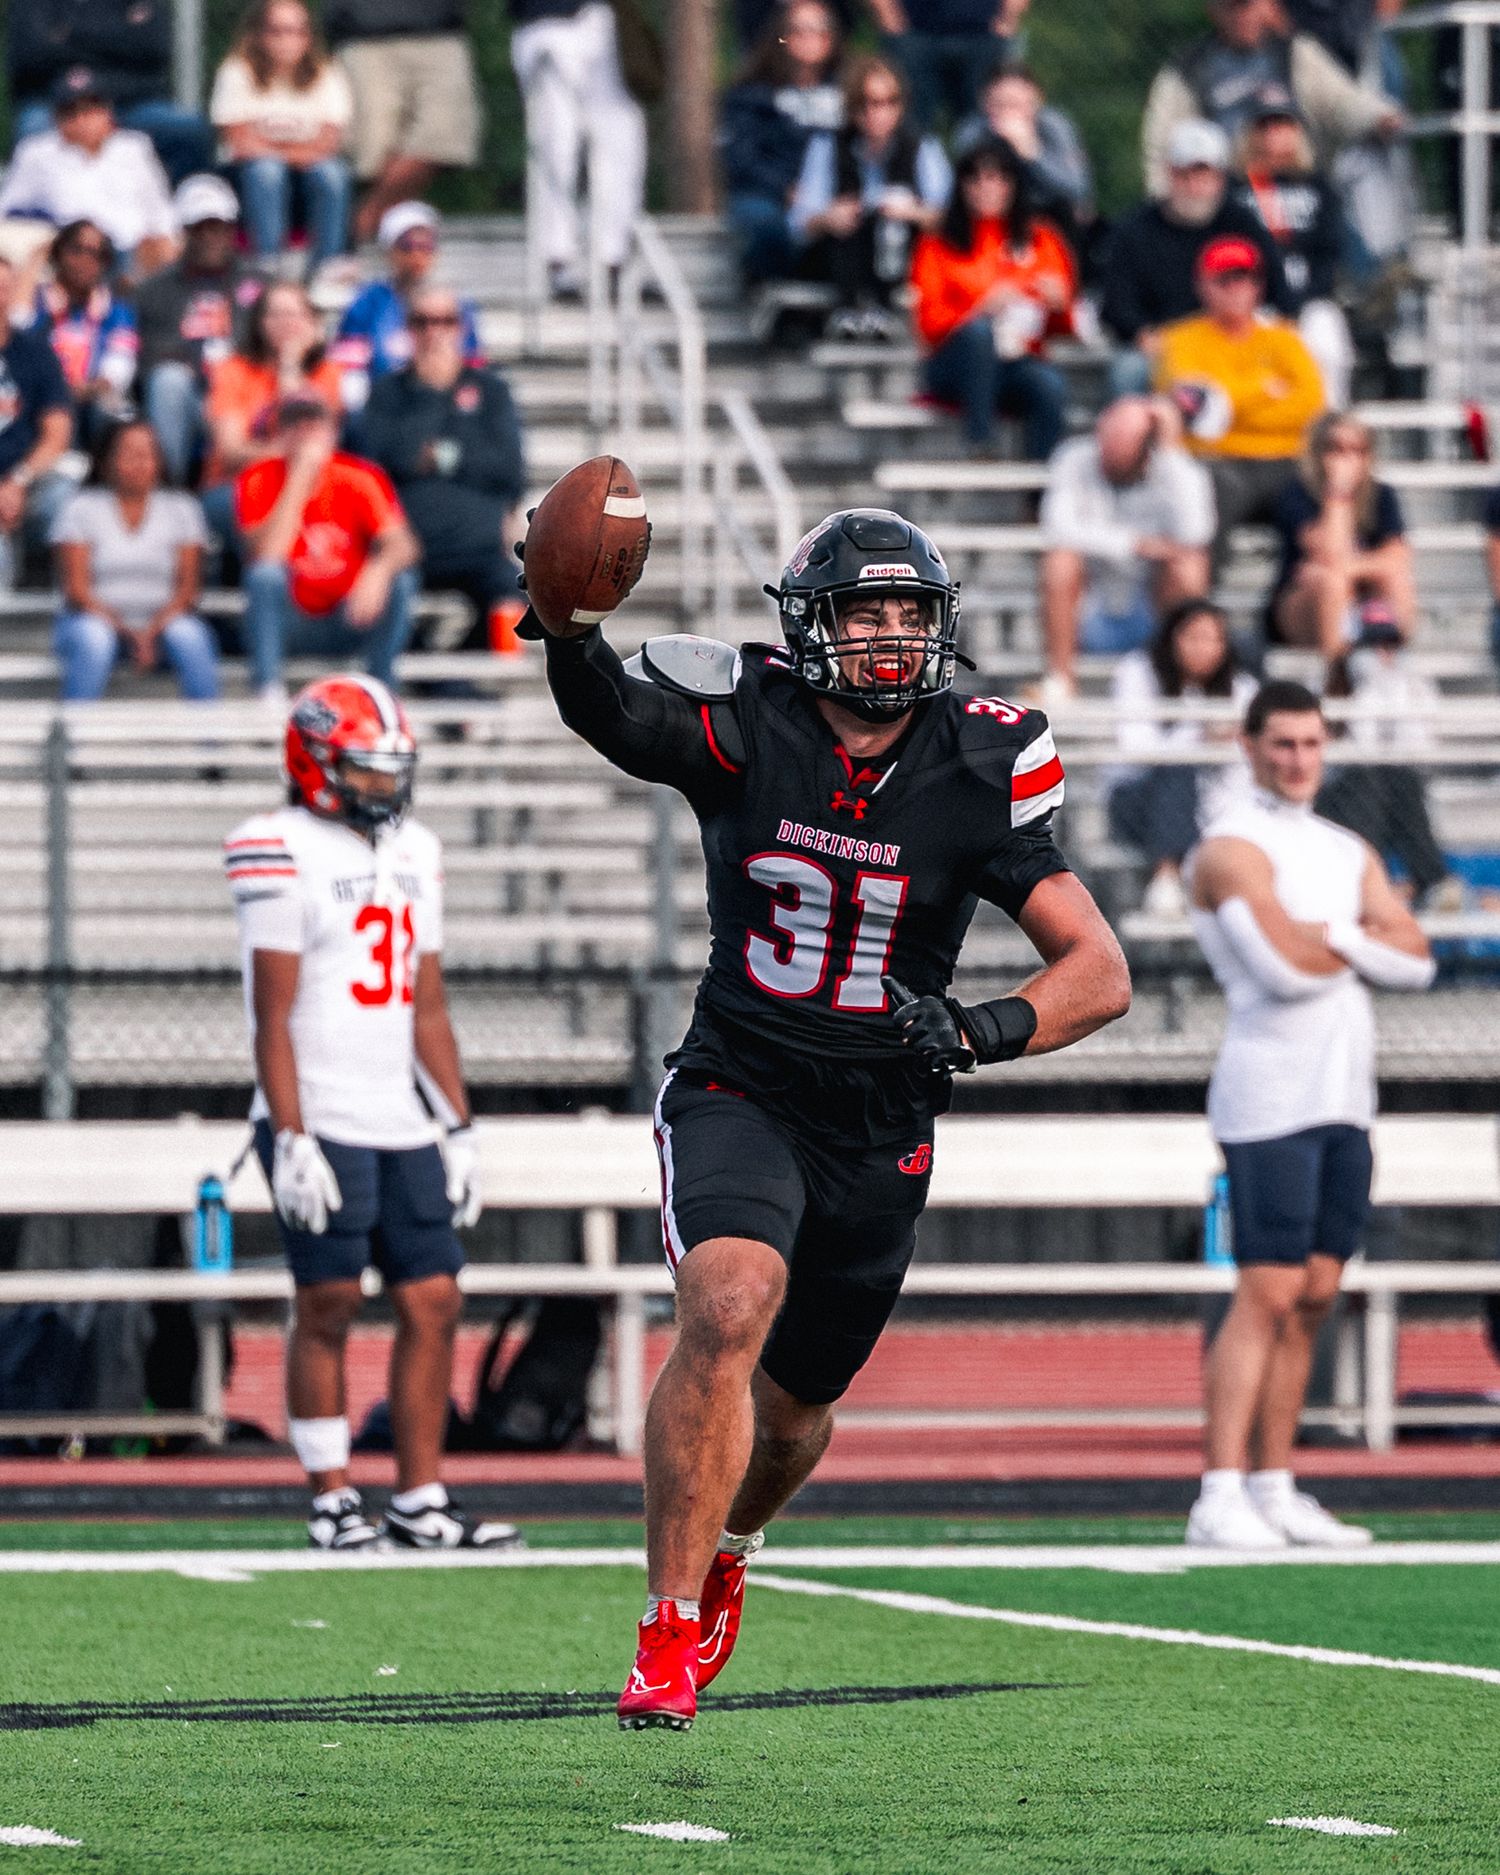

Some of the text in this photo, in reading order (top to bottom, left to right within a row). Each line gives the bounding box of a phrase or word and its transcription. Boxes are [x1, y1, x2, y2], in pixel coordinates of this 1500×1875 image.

[866, 567, 912, 577] Riddell
[775, 818, 901, 867] DICKINSON
[742, 851, 911, 1013] 31
